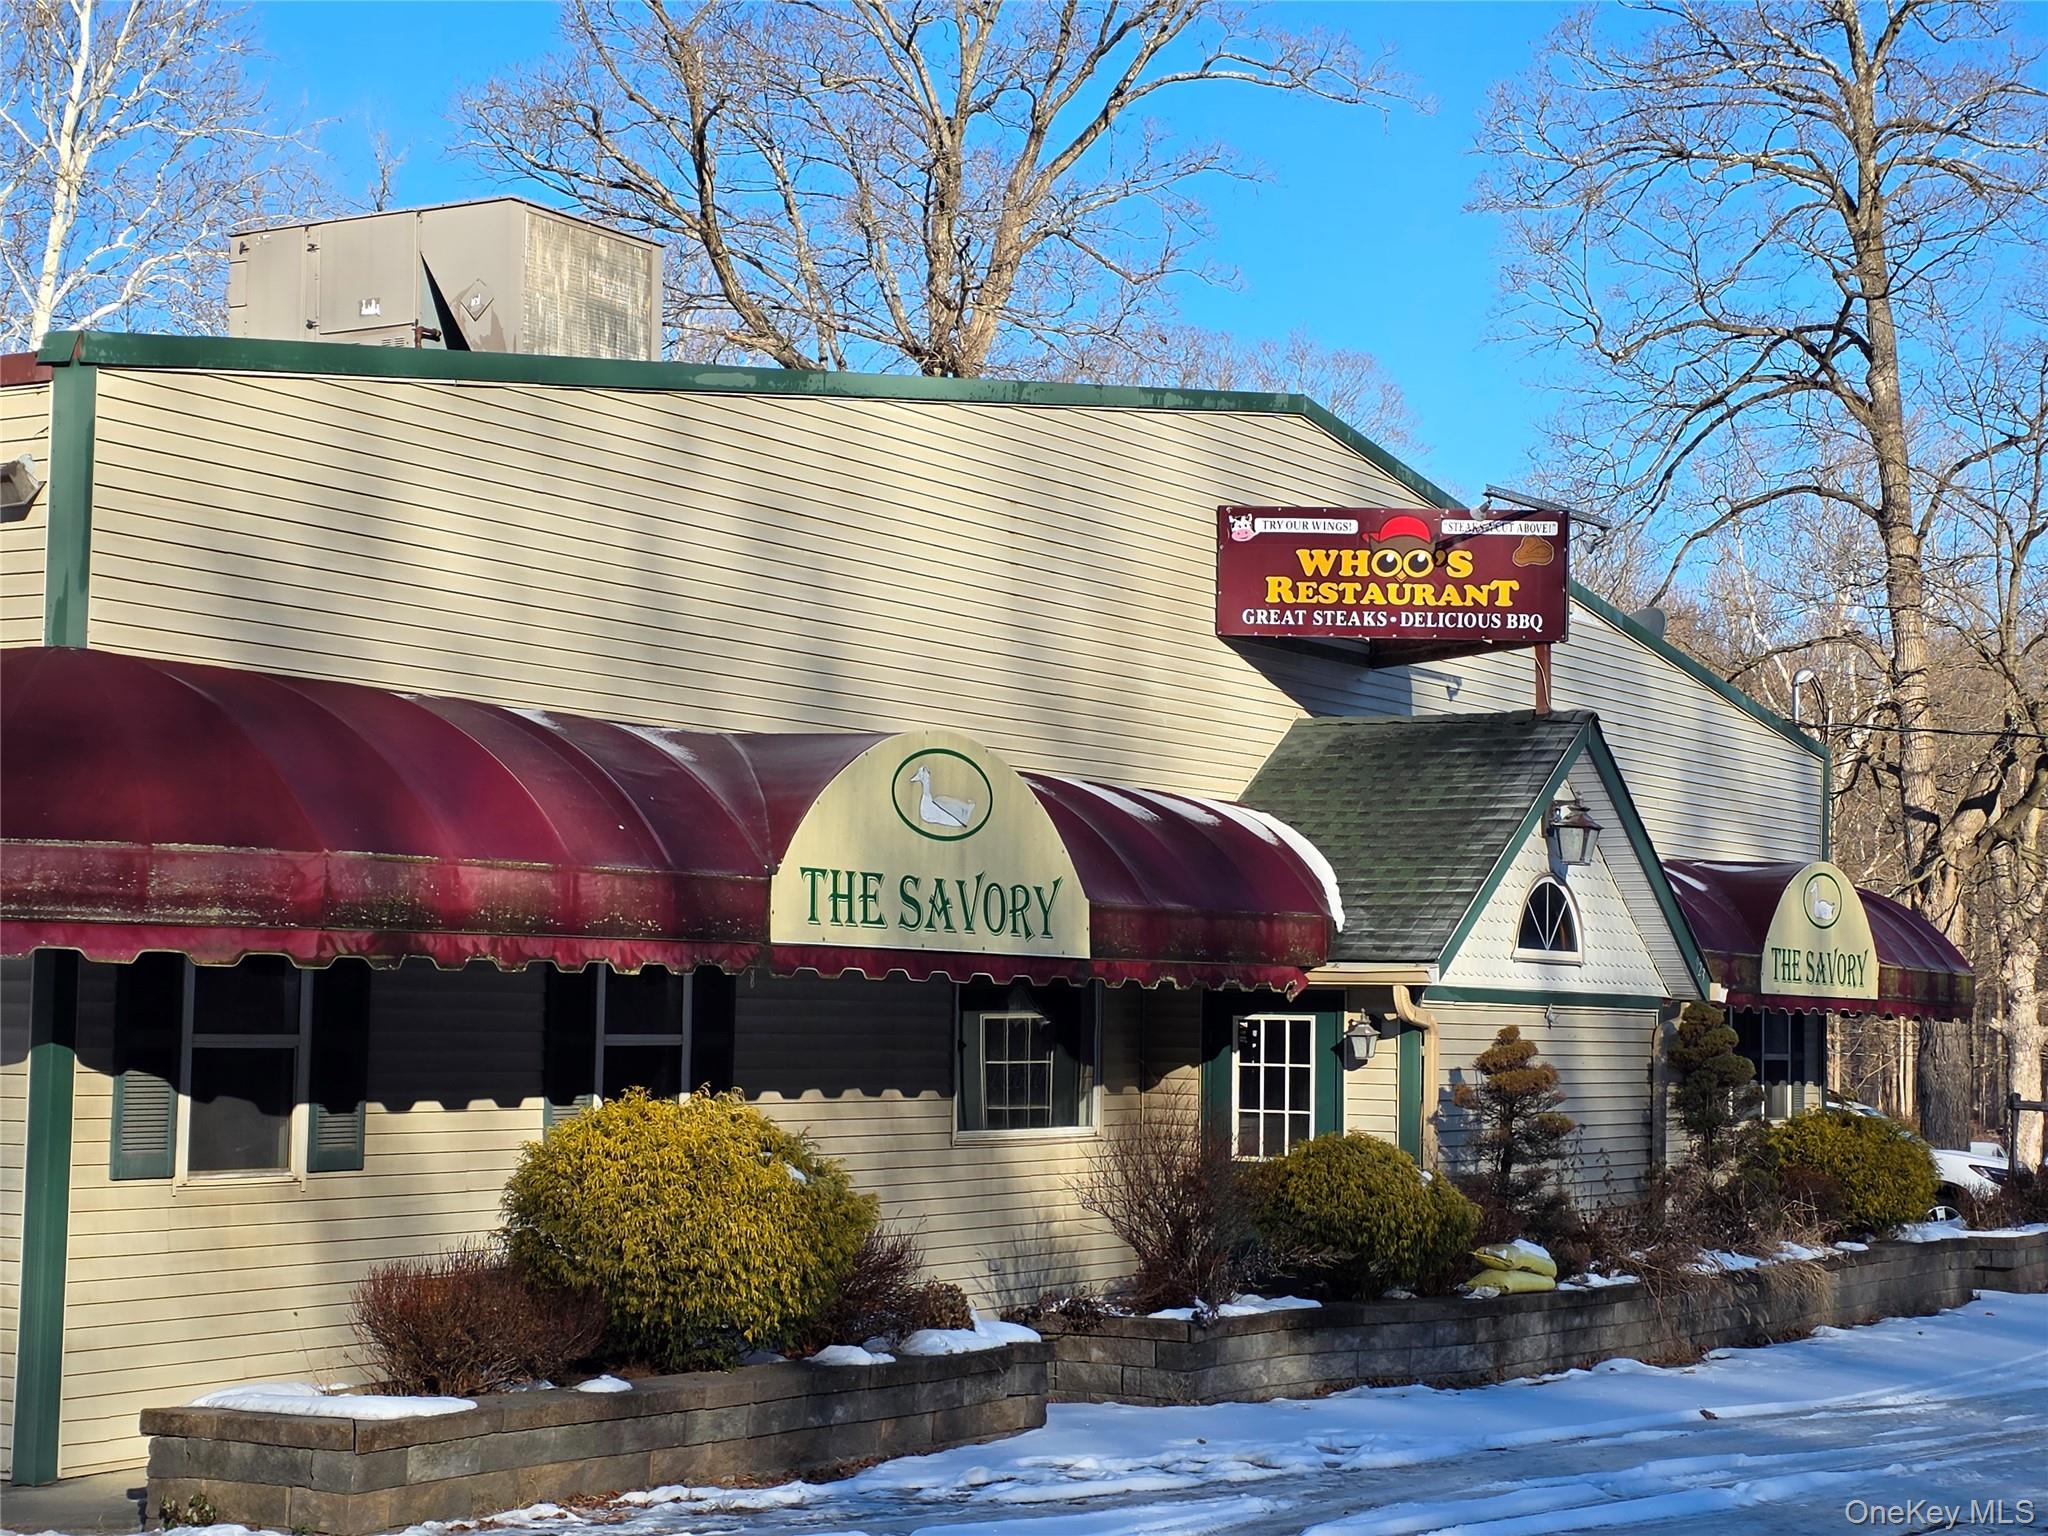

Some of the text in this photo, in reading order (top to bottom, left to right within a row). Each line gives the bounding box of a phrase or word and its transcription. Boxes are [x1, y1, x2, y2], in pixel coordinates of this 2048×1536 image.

[1262, 520, 1353, 532] TRY OUR WINGS!
[1296, 549, 1473, 579] WHOO'S
[1242, 608, 1543, 633] GREAT STEAKS DELICIOUS BBQ
[800, 867, 1064, 942] THE SAVORY
[1771, 947, 1869, 988] THE SAVORY
